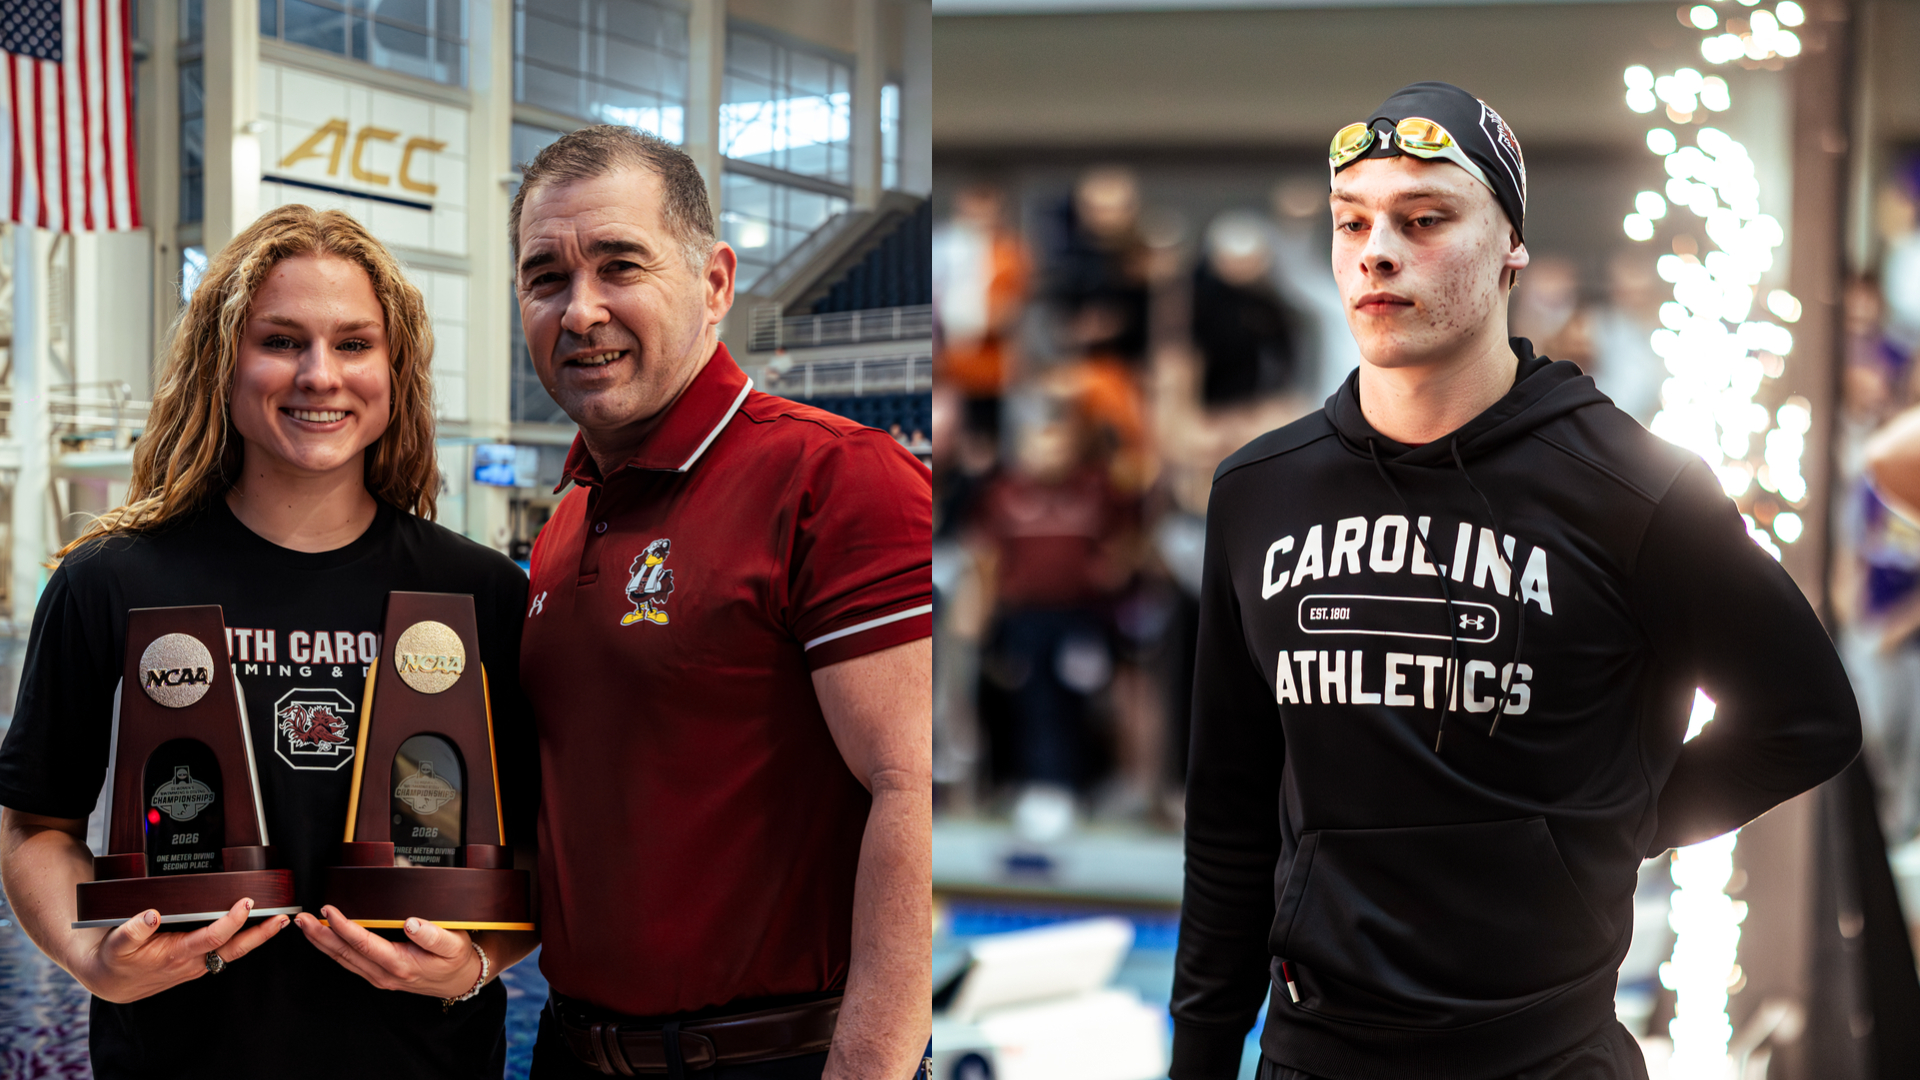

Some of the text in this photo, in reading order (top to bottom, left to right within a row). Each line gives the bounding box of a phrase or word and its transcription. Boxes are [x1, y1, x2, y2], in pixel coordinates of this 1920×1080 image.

[277, 118, 447, 197] ACC
[1261, 514, 1553, 615] CAROLINA
[1310, 607, 1350, 620] EST. 1801
[400, 653, 462, 676] NCAA
[146, 666, 210, 689] NCAA
[331, 665, 343, 678] &
[1276, 650, 1534, 715] ATHLETICS
[153, 793, 214, 805] CHAMPIONSHIPS
[396, 788, 455, 798] CHAMPIONSHIPS
[171, 832, 200, 845] 2026
[411, 826, 439, 838] 2026
[394, 846, 456, 855] THREE METER DIVING
[156, 852, 215, 863] ONE METER DIVING
[408, 855, 441, 864] CHAMPION
[162, 862, 189, 871] SECOND
